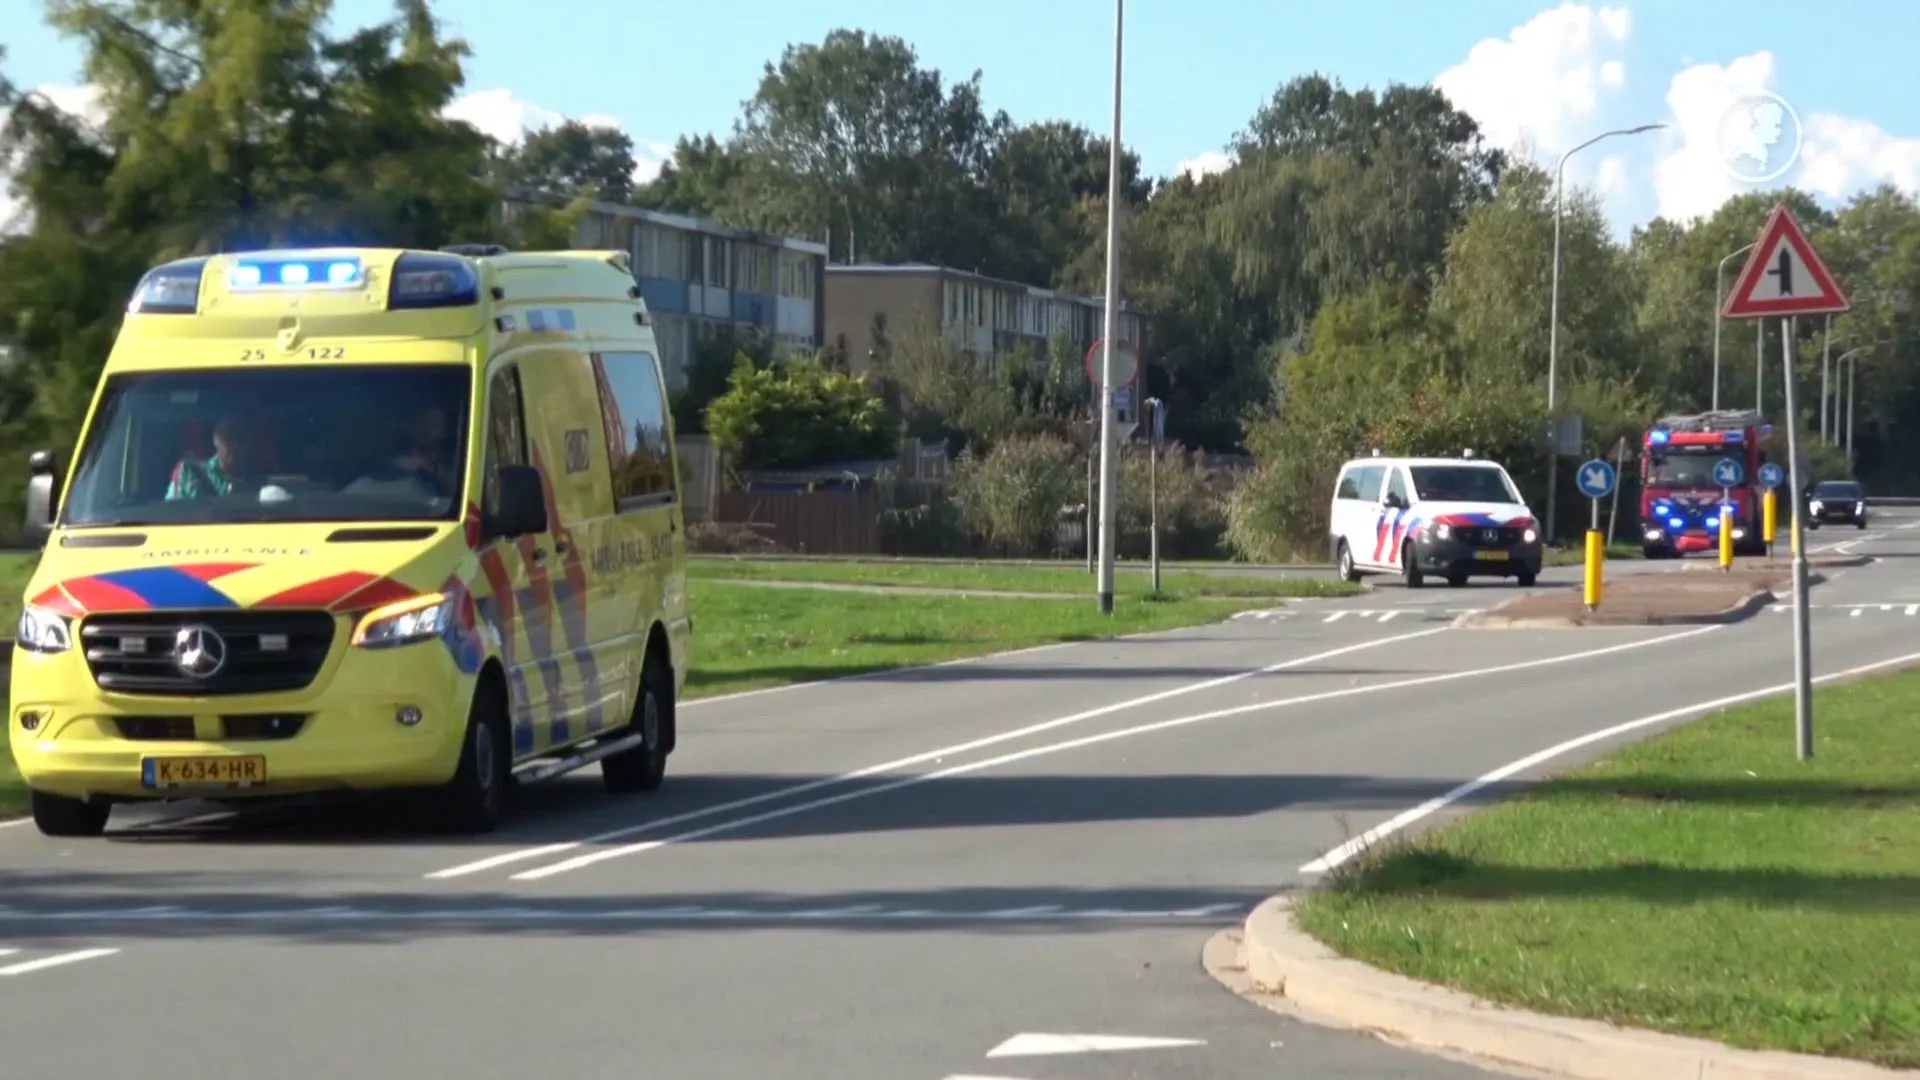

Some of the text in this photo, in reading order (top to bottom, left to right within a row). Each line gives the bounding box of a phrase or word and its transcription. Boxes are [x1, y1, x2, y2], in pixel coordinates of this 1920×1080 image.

[240, 347, 345, 361] 25 122
[160, 761, 257, 780] K-634-HR
